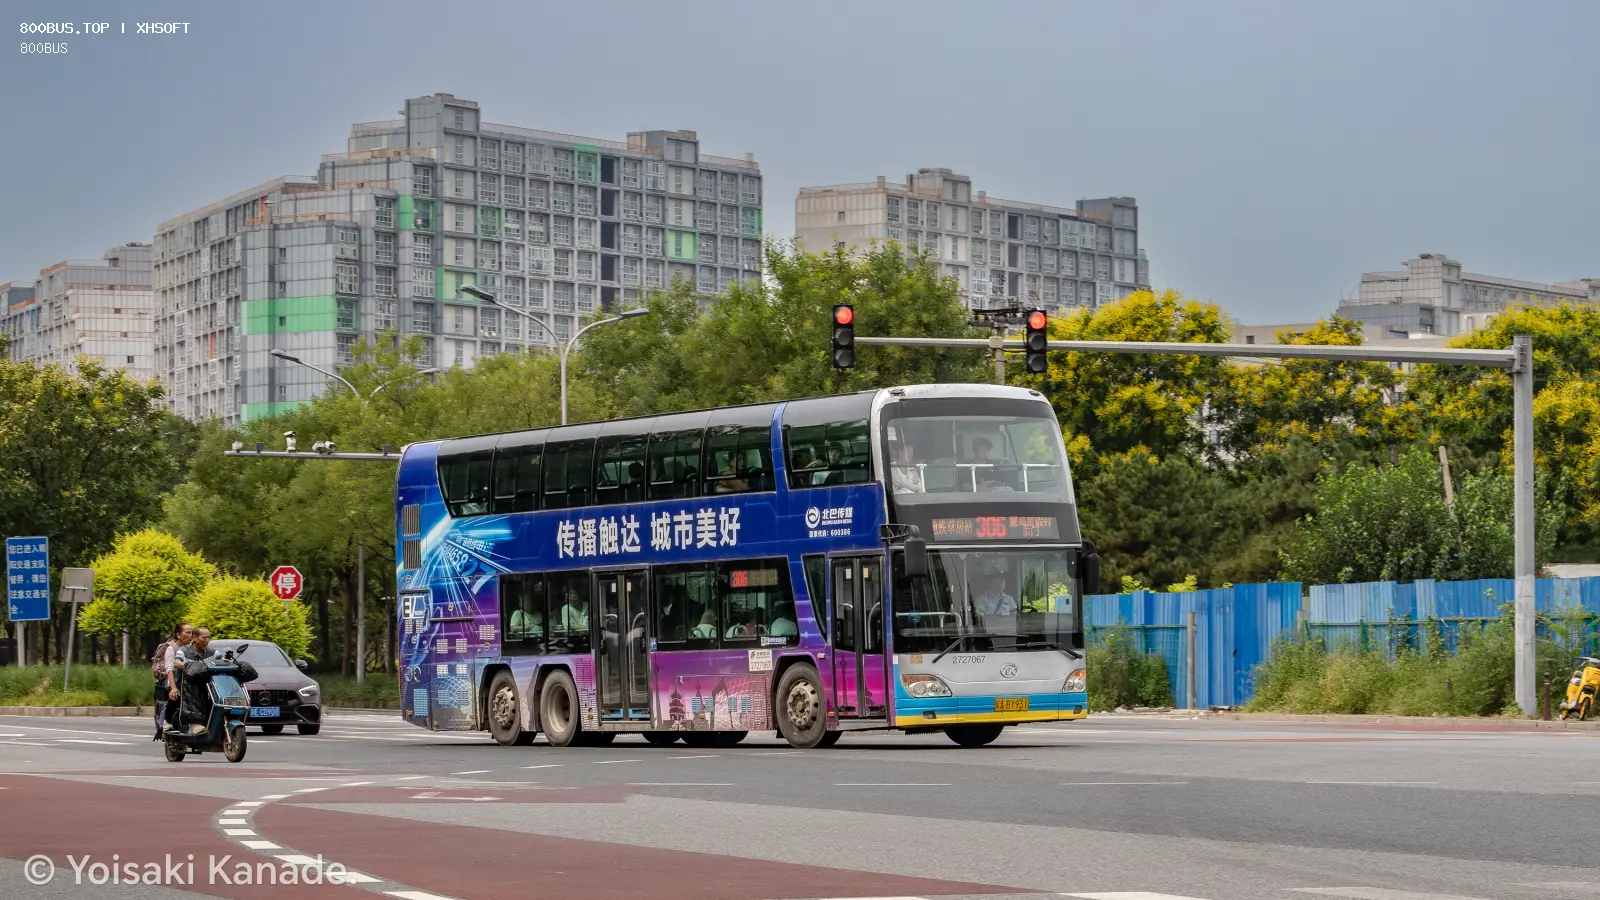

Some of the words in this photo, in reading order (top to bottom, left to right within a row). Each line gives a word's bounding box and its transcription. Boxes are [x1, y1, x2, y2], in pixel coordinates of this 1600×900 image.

[821, 507, 853, 520] 北巴传媒
[556, 513, 641, 559] 传播触达
[650, 506, 741, 551] 城市美好
[275, 572, 297, 595] 停
[952, 655, 986, 664] 2727067
